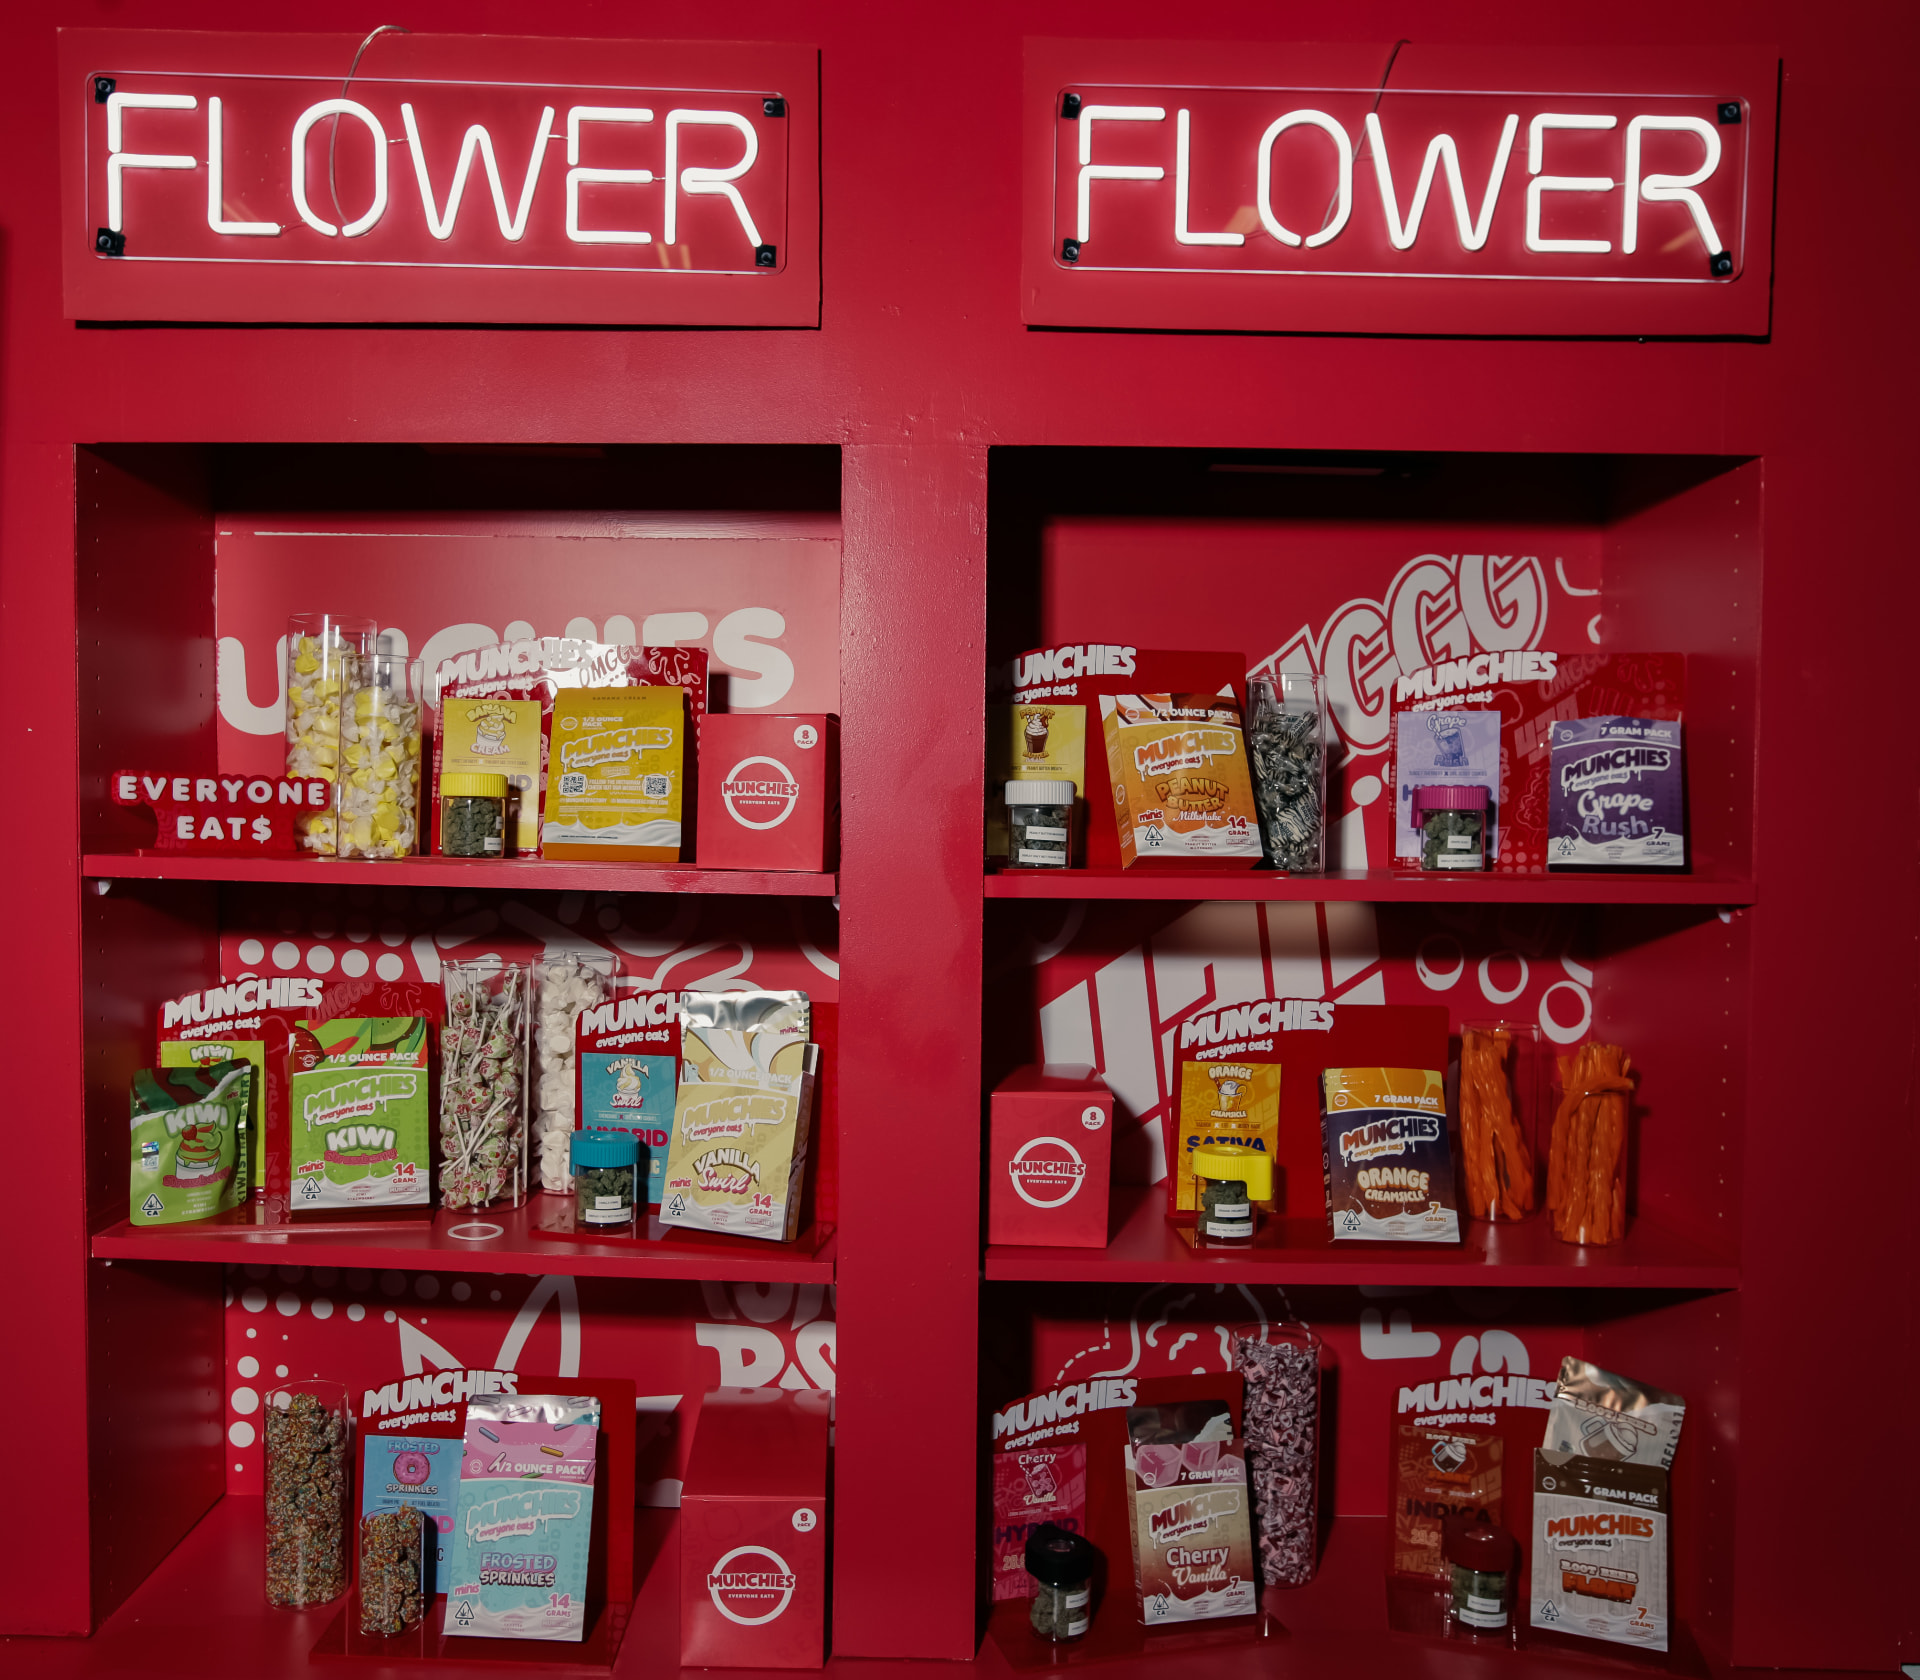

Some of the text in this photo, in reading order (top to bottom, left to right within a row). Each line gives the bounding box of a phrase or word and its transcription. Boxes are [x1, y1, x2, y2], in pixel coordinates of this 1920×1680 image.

[106, 91, 762, 247] FLOWER
[1076, 104, 1722, 255] FLOWER
[441, 639, 592, 687] MUNCHIES
[1396, 651, 1558, 703] MUNCHIES
[456, 680, 506, 698] everyone
[1411, 693, 1466, 712] everyone
[465, 703, 517, 724] BANANA
[1019, 706, 1056, 720] PEANUT
[1151, 708, 1234, 720] 1/2 OUNCE PACK
[1426, 713, 1467, 732] Grape
[802, 729, 810, 739] 8
[1600, 727, 1672, 738] 7 GRAM PACK
[470, 743, 511, 755] CREAM
[562, 727, 673, 763] MUNCHIES
[1136, 730, 1236, 766] MUNCHIES
[1150, 758, 1184, 772] everyone
[1564, 748, 1670, 782] MUNCHIES
[118, 775, 327, 805] EVERYONE
[722, 781, 799, 797] MUNCHIES
[1155, 777, 1229, 801] PEANUT
[1165, 795, 1224, 813] BUTTER
[1577, 790, 1654, 821] Grape
[1138, 808, 1164, 823] minis
[1173, 811, 1222, 821] Milkshake
[1228, 815, 1248, 829] 14
[177, 815, 273, 844] EAT$
[1582, 813, 1649, 836] Rush
[1652, 827, 1665, 840] 7
[163, 977, 324, 1029] MUNCHIES
[581, 991, 681, 1036] MUNCH
[180, 1021, 233, 1040] everyone
[1180, 1000, 1335, 1048] MUNCHIES
[595, 1031, 644, 1048] everyone
[190, 1044, 234, 1062] KIWI
[328, 1052, 419, 1063] 1/2 OUNCE PACK
[1195, 1042, 1247, 1060] everyone
[606, 1058, 649, 1080] VANILLA
[1208, 1065, 1253, 1080] ORANGE
[305, 1074, 417, 1118] MUNCHIES
[610, 1094, 644, 1108] Swirl
[1374, 1094, 1439, 1106] 7 GRAM PACK
[165, 1103, 229, 1137] KIWI
[319, 1105, 355, 1121] everyone
[683, 1095, 787, 1130] MUNCHIES
[1089, 1111, 1097, 1121] 8
[1210, 1109, 1247, 1119] CREAMSICLE
[326, 1125, 397, 1151] KIWI
[693, 1124, 725, 1136] everyone
[1342, 1117, 1440, 1152] MUNCHIES
[1354, 1146, 1387, 1158] everyone
[298, 1161, 325, 1175] minis
[394, 1163, 416, 1176] 14
[692, 1148, 760, 1186] VANILLA
[1009, 1161, 1086, 1176] MUNCHIES
[669, 1178, 692, 1189] minis
[698, 1166, 752, 1195] Swirl
[1357, 1167, 1430, 1193] ORANGE
[753, 1193, 772, 1209] 14
[1364, 1189, 1426, 1203] CREAMSICLE
[749, 1208, 773, 1217] GRAMS
[1430, 1202, 1440, 1215] 7
[362, 1369, 519, 1418] MUNCHIES
[992, 1379, 1138, 1440] MUNCHIES
[378, 1412, 429, 1430] everyone
[1413, 1413, 1468, 1428] everyone
[1004, 1426, 1054, 1450] everyone
[388, 1441, 440, 1455] FROSTED
[1018, 1453, 1057, 1465] Cherry
[495, 1462, 586, 1475] 1/2 OUNCE PACK
[1180, 1467, 1241, 1481] 7 GRAM PACK
[385, 1483, 438, 1495] SPRINKLES
[1584, 1485, 1659, 1504] 7 GRAM PACK
[1022, 1491, 1057, 1506] Vanilla
[466, 1489, 581, 1533] MUNCHIES
[800, 1512, 808, 1522] 8
[1150, 1489, 1240, 1533] MUNCHIES
[480, 1523, 515, 1538] everyone
[1162, 1524, 1192, 1540] everyone
[1547, 1513, 1655, 1538] MUNCHIES
[1558, 1538, 1593, 1549] everyone
[480, 1552, 558, 1573] FROSTED
[1166, 1546, 1230, 1568] Cherry
[479, 1571, 556, 1587] SPRINKLES
[1171, 1564, 1228, 1587] Vanilla
[1560, 1559, 1639, 1584] ROOT BEER
[708, 1573, 795, 1589] MUNCHIES
[1230, 1576, 1240, 1590] 7
[1562, 1571, 1636, 1604] FLOAT
[454, 1583, 480, 1596] minis
[1226, 1590, 1246, 1598] GRAMS
[549, 1593, 571, 1609] 14
[1637, 1607, 1648, 1619] 7
[1630, 1620, 1655, 1630] GRAMS
